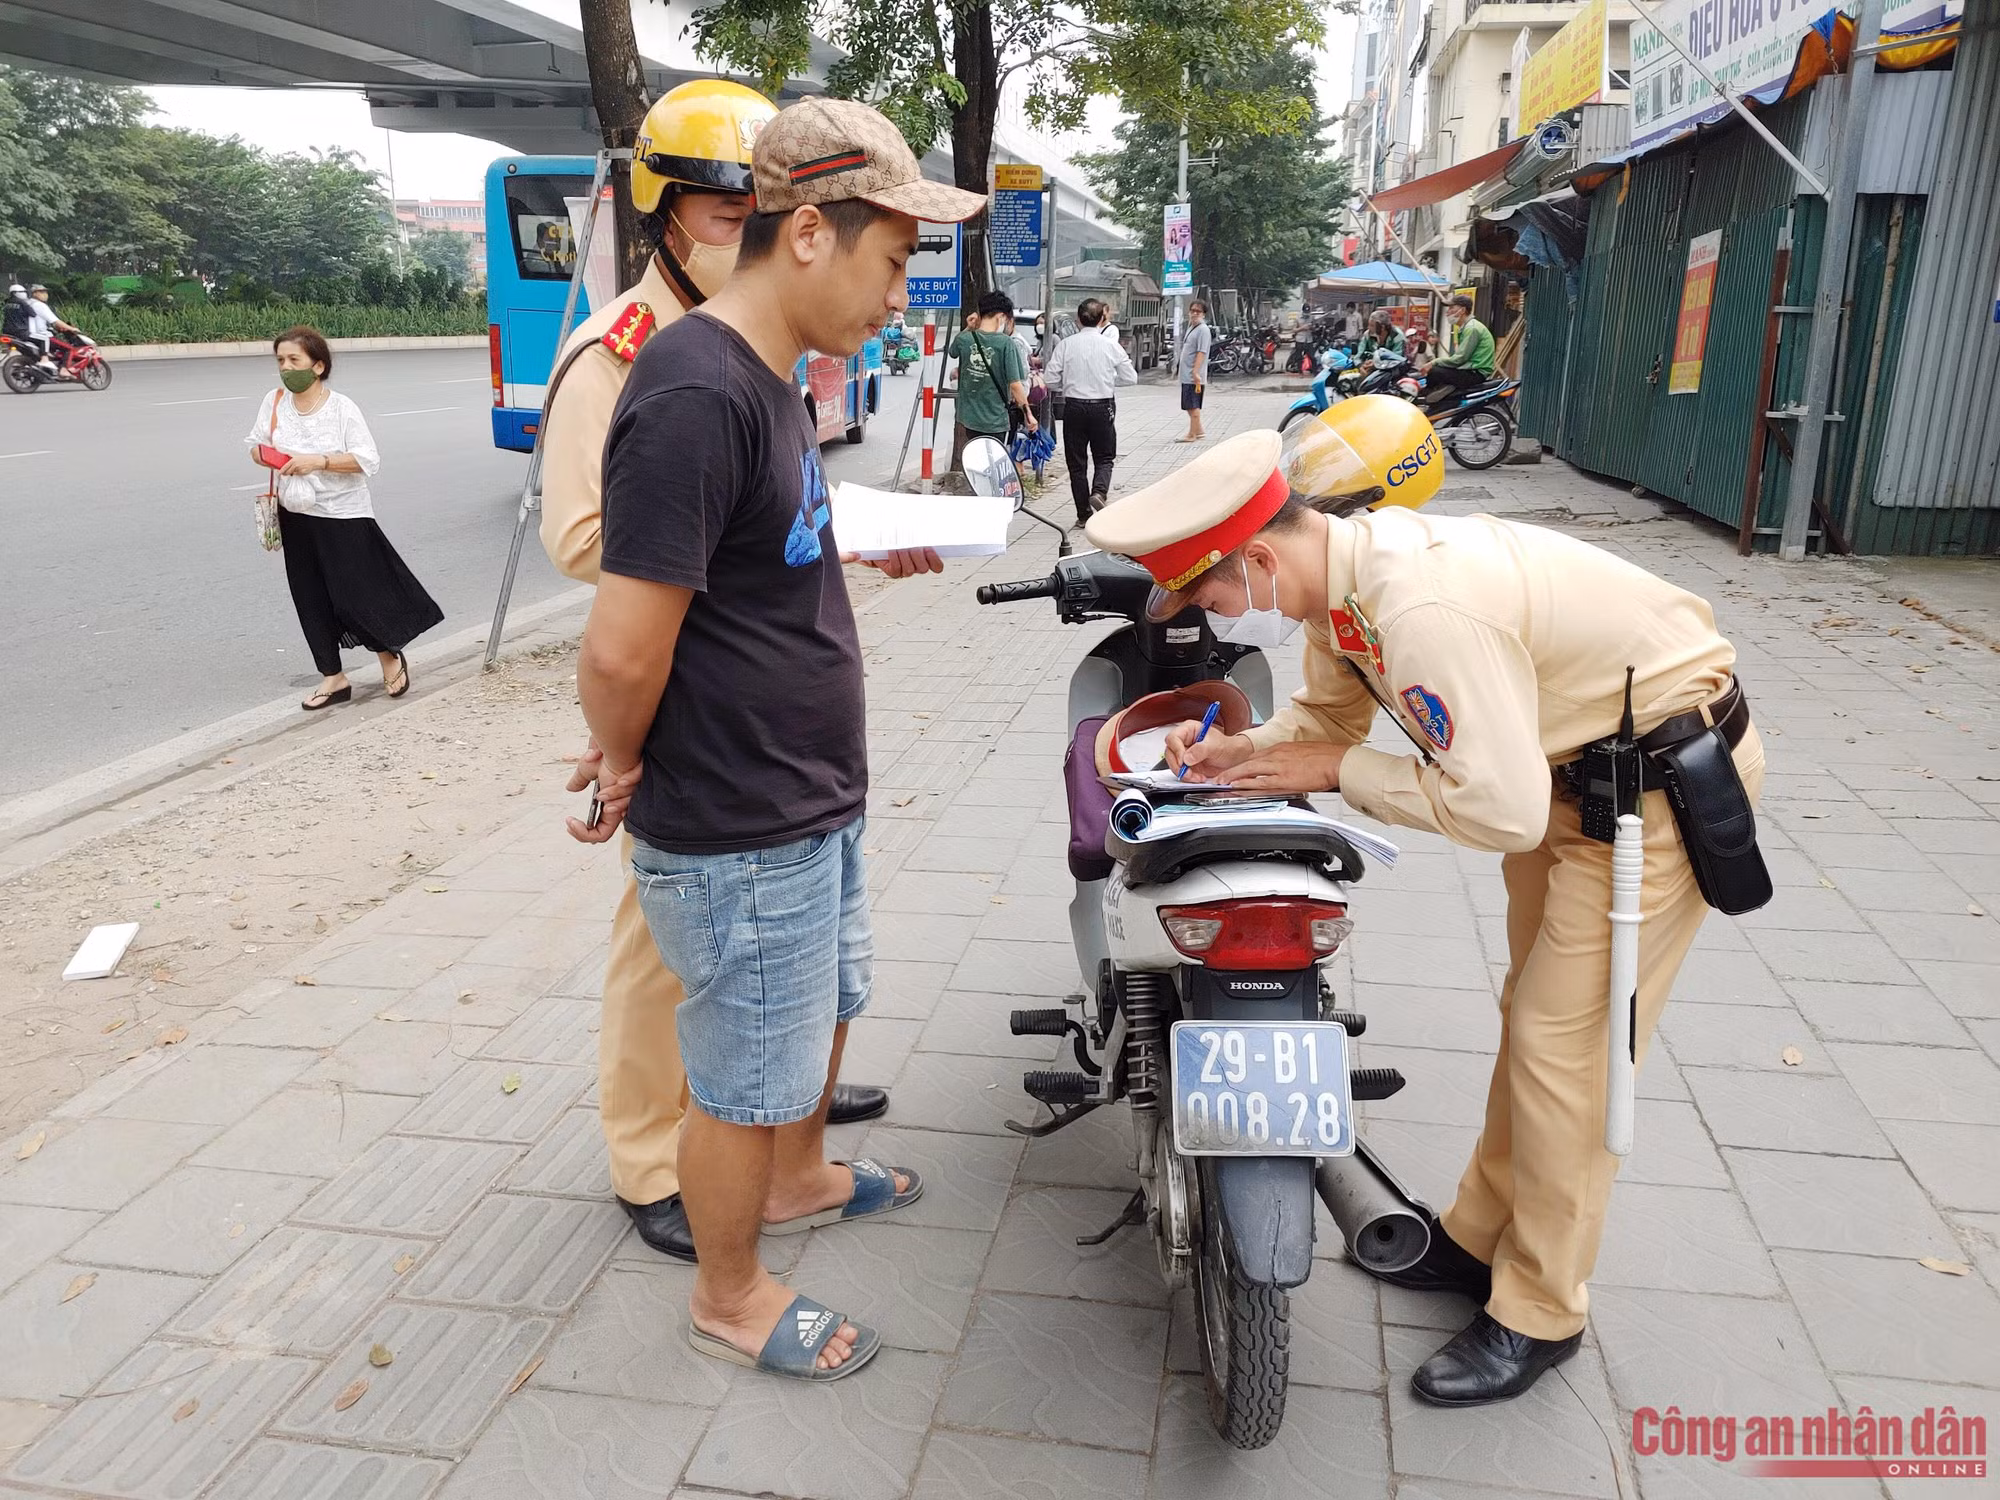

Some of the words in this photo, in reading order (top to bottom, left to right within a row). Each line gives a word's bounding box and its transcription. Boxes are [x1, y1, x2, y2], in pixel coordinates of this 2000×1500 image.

[909, 294, 923, 303] US
[924, 294, 949, 304] STOP
[919, 281, 931, 291] XE
[933, 278, 957, 291] BUÝT
[1386, 433, 1438, 487] CSGT
[1230, 982, 1285, 990] HONDA
[1199, 1030, 1319, 1085] 29-B1
[1186, 1090, 1342, 1147] 008.28
[803, 1310, 834, 1348] adidas
